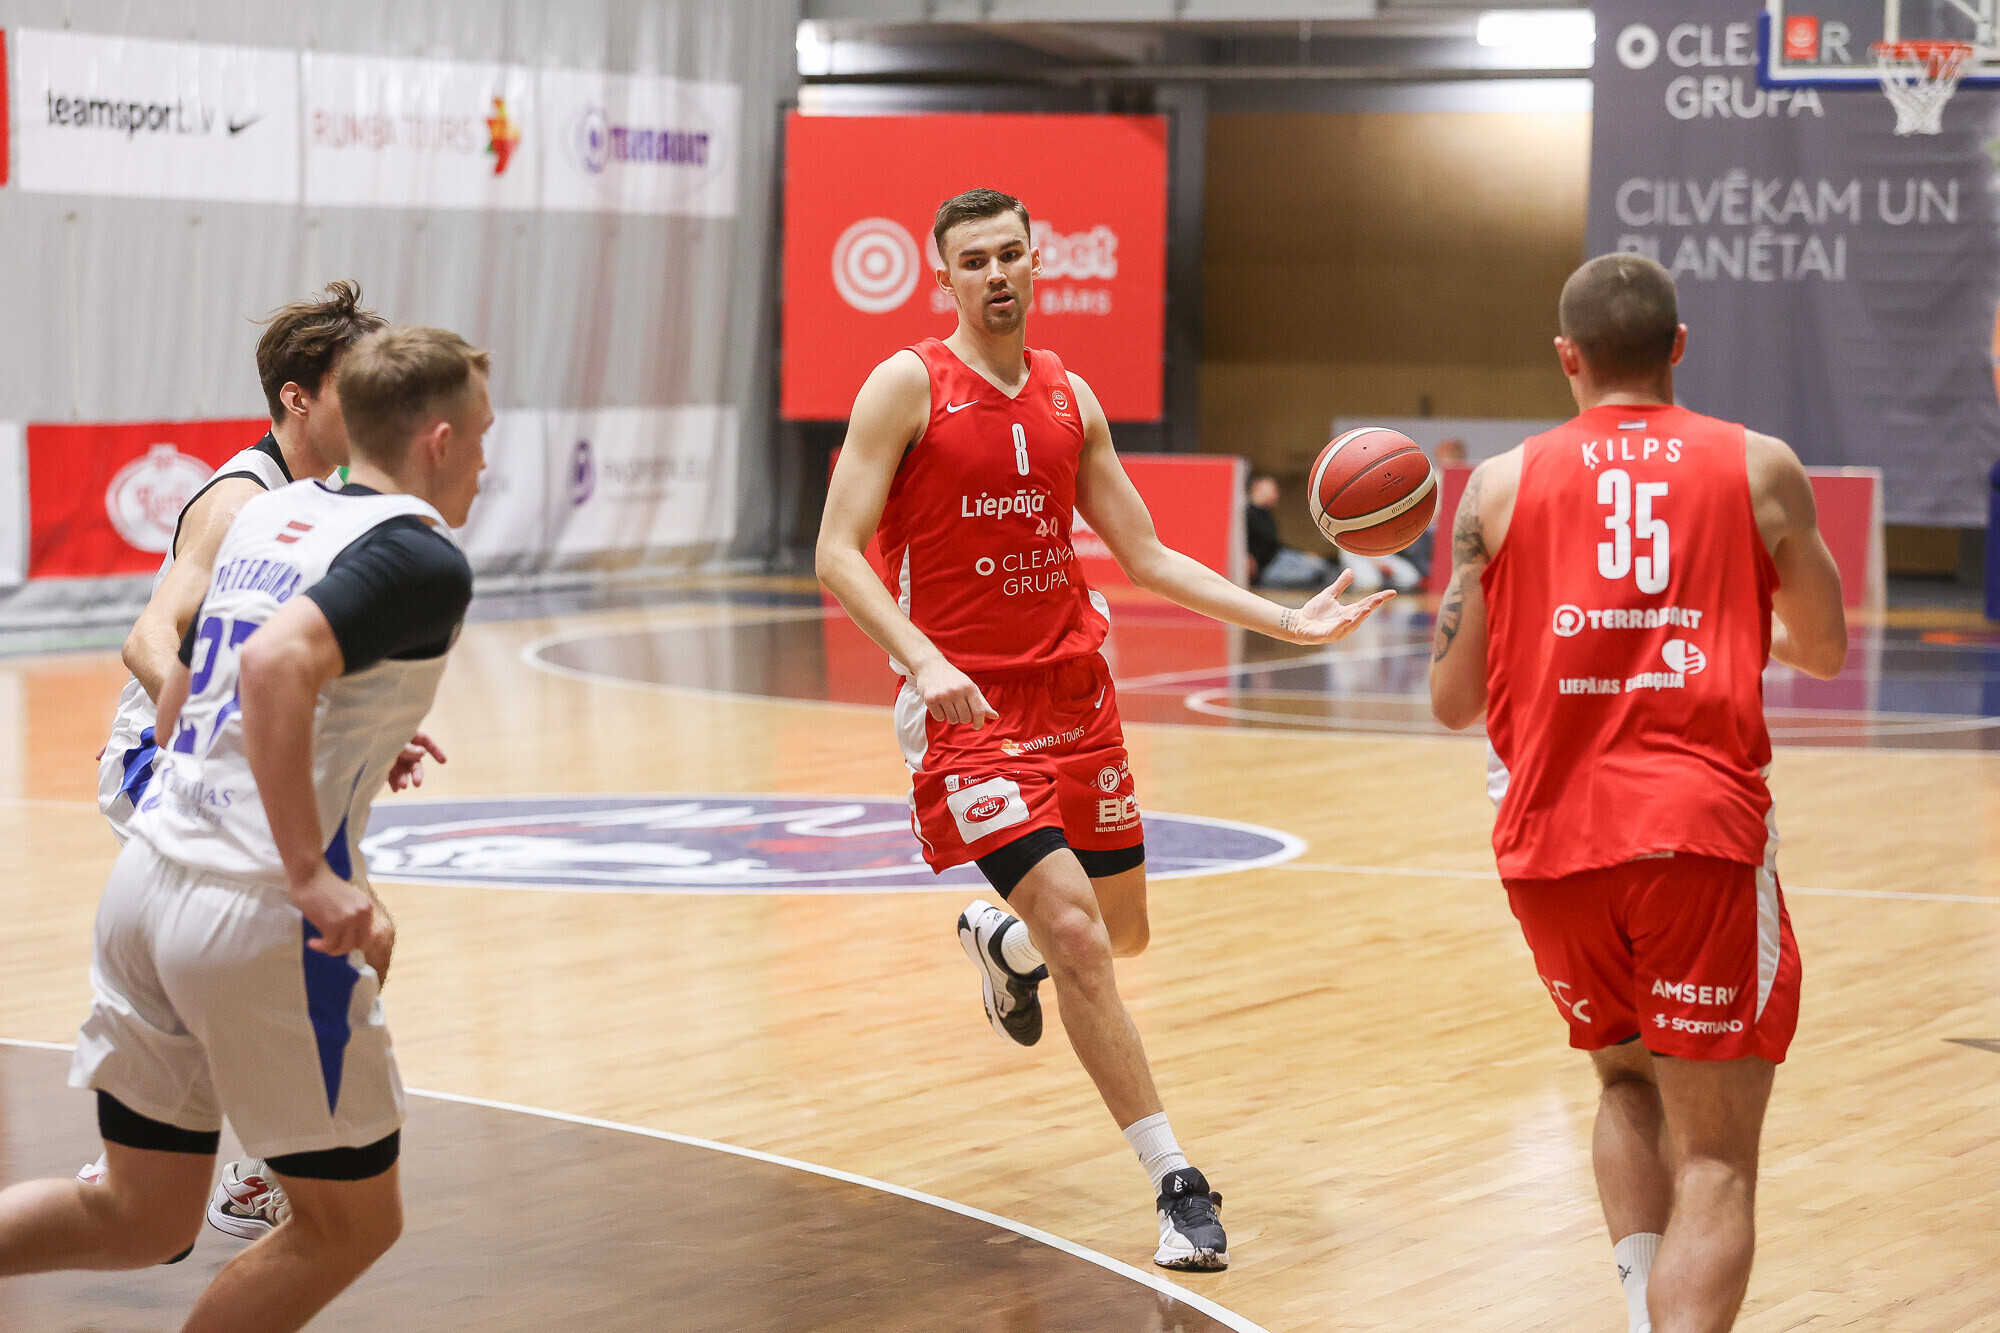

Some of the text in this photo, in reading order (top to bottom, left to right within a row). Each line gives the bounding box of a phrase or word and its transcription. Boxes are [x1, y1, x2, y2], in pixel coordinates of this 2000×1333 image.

[1615, 167, 1960, 227] CILVĒKAM UN
[1011, 422, 1031, 476] 8
[1581, 437, 1683, 470] ĶILPS
[961, 488, 1046, 521] Liepāja
[1597, 468, 1670, 595] 35
[1003, 569, 1069, 596] GRUPA
[1586, 607, 1703, 630] TERRABALT
[1022, 725, 1085, 752] RUMBA TOURS
[1651, 979, 1740, 1006] AMSERV
